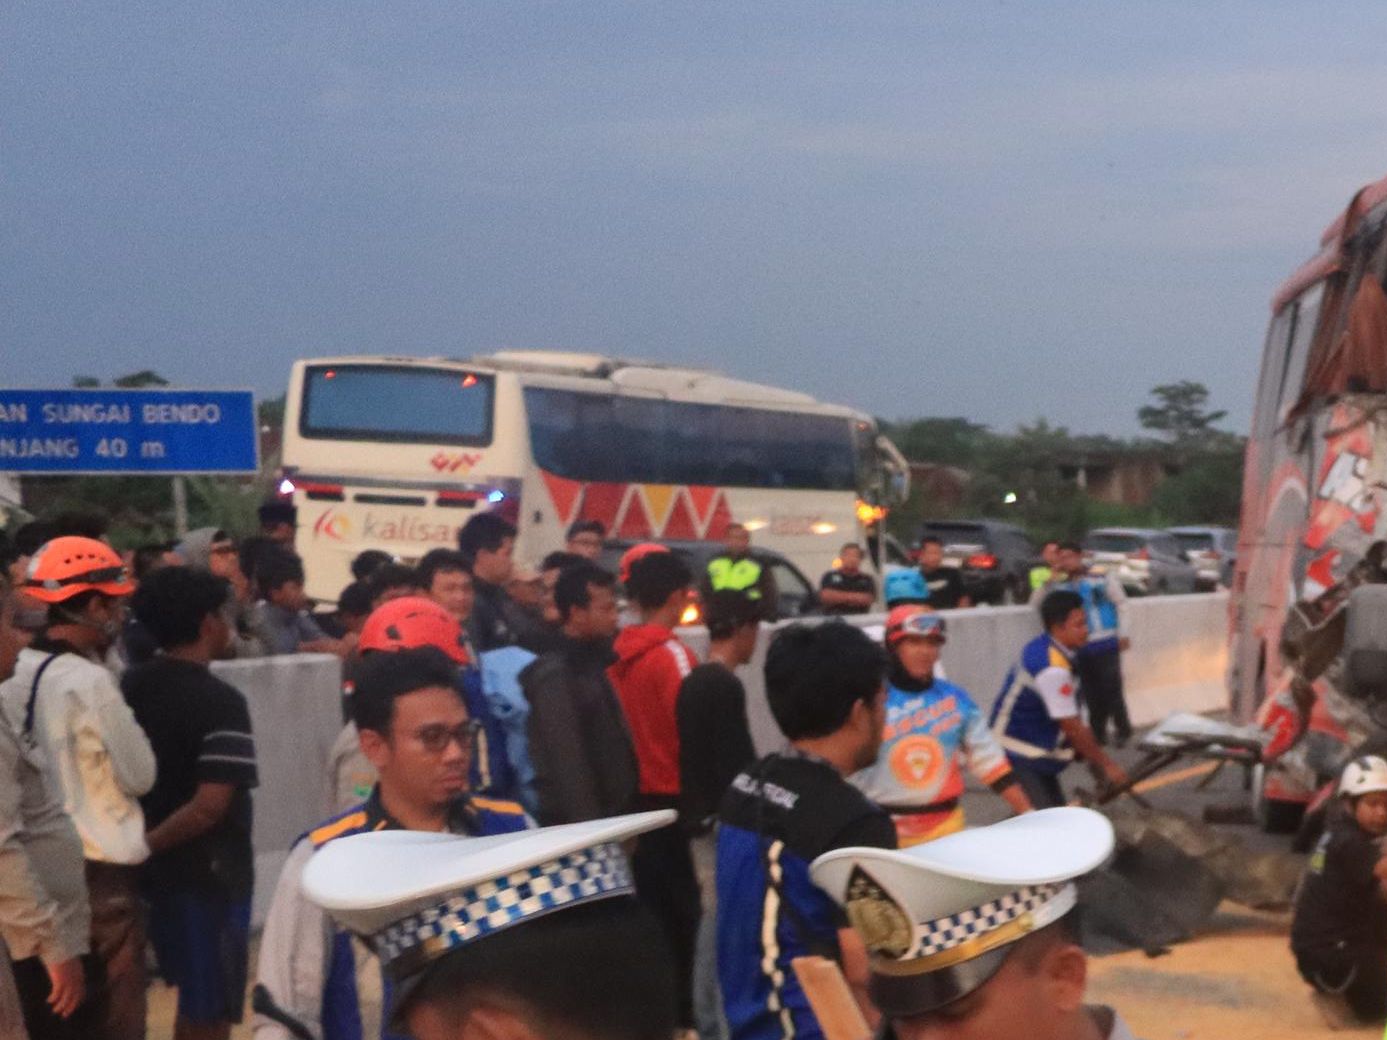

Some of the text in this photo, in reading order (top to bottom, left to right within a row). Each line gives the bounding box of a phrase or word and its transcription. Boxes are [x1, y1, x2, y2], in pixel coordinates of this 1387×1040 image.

[42, 403, 131, 424] SUNGAI
[142, 404, 221, 425] BENDO
[95, 438, 128, 459] 40
[140, 441, 165, 458] m
